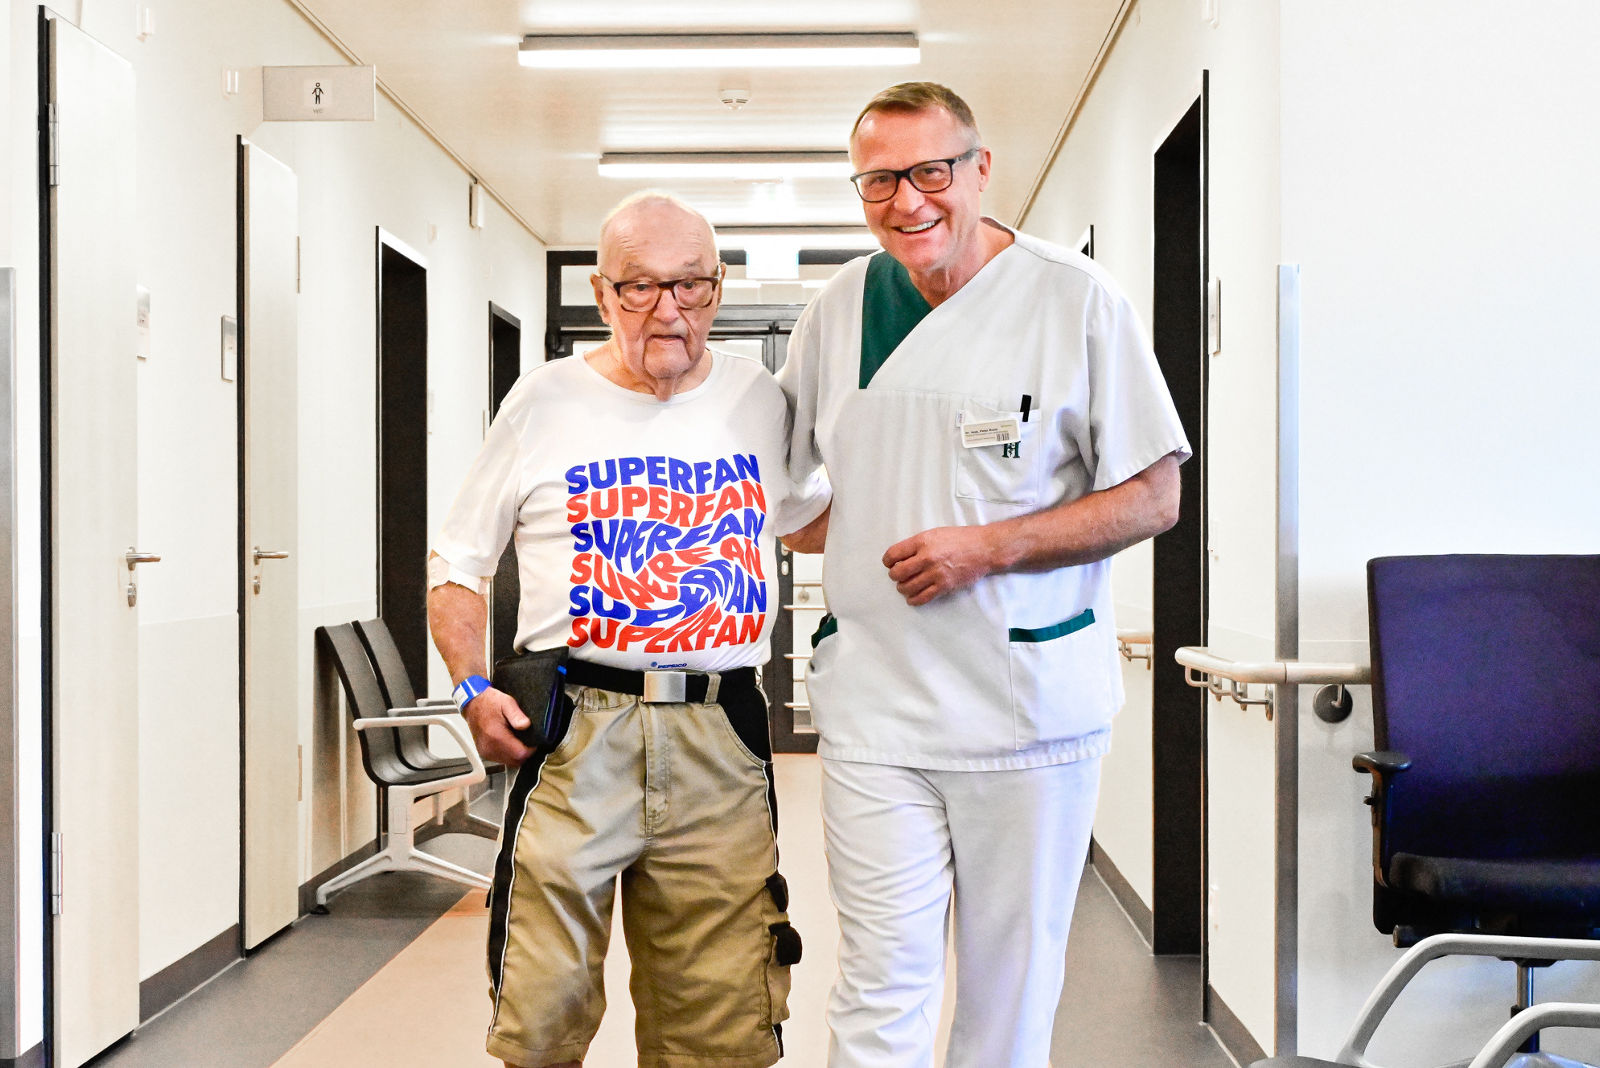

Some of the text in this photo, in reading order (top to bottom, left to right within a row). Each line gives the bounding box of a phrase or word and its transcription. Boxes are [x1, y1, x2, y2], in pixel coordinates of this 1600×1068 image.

[565, 453, 761, 495] SUPERFAN
[566, 480, 767, 527] SUPERFAN
[570, 508, 765, 574] SUPERFAN
[568, 560, 767, 627] SUPERFAN
[569, 537, 766, 610] SUPERFAN
[566, 601, 766, 653] SUPERFAN
